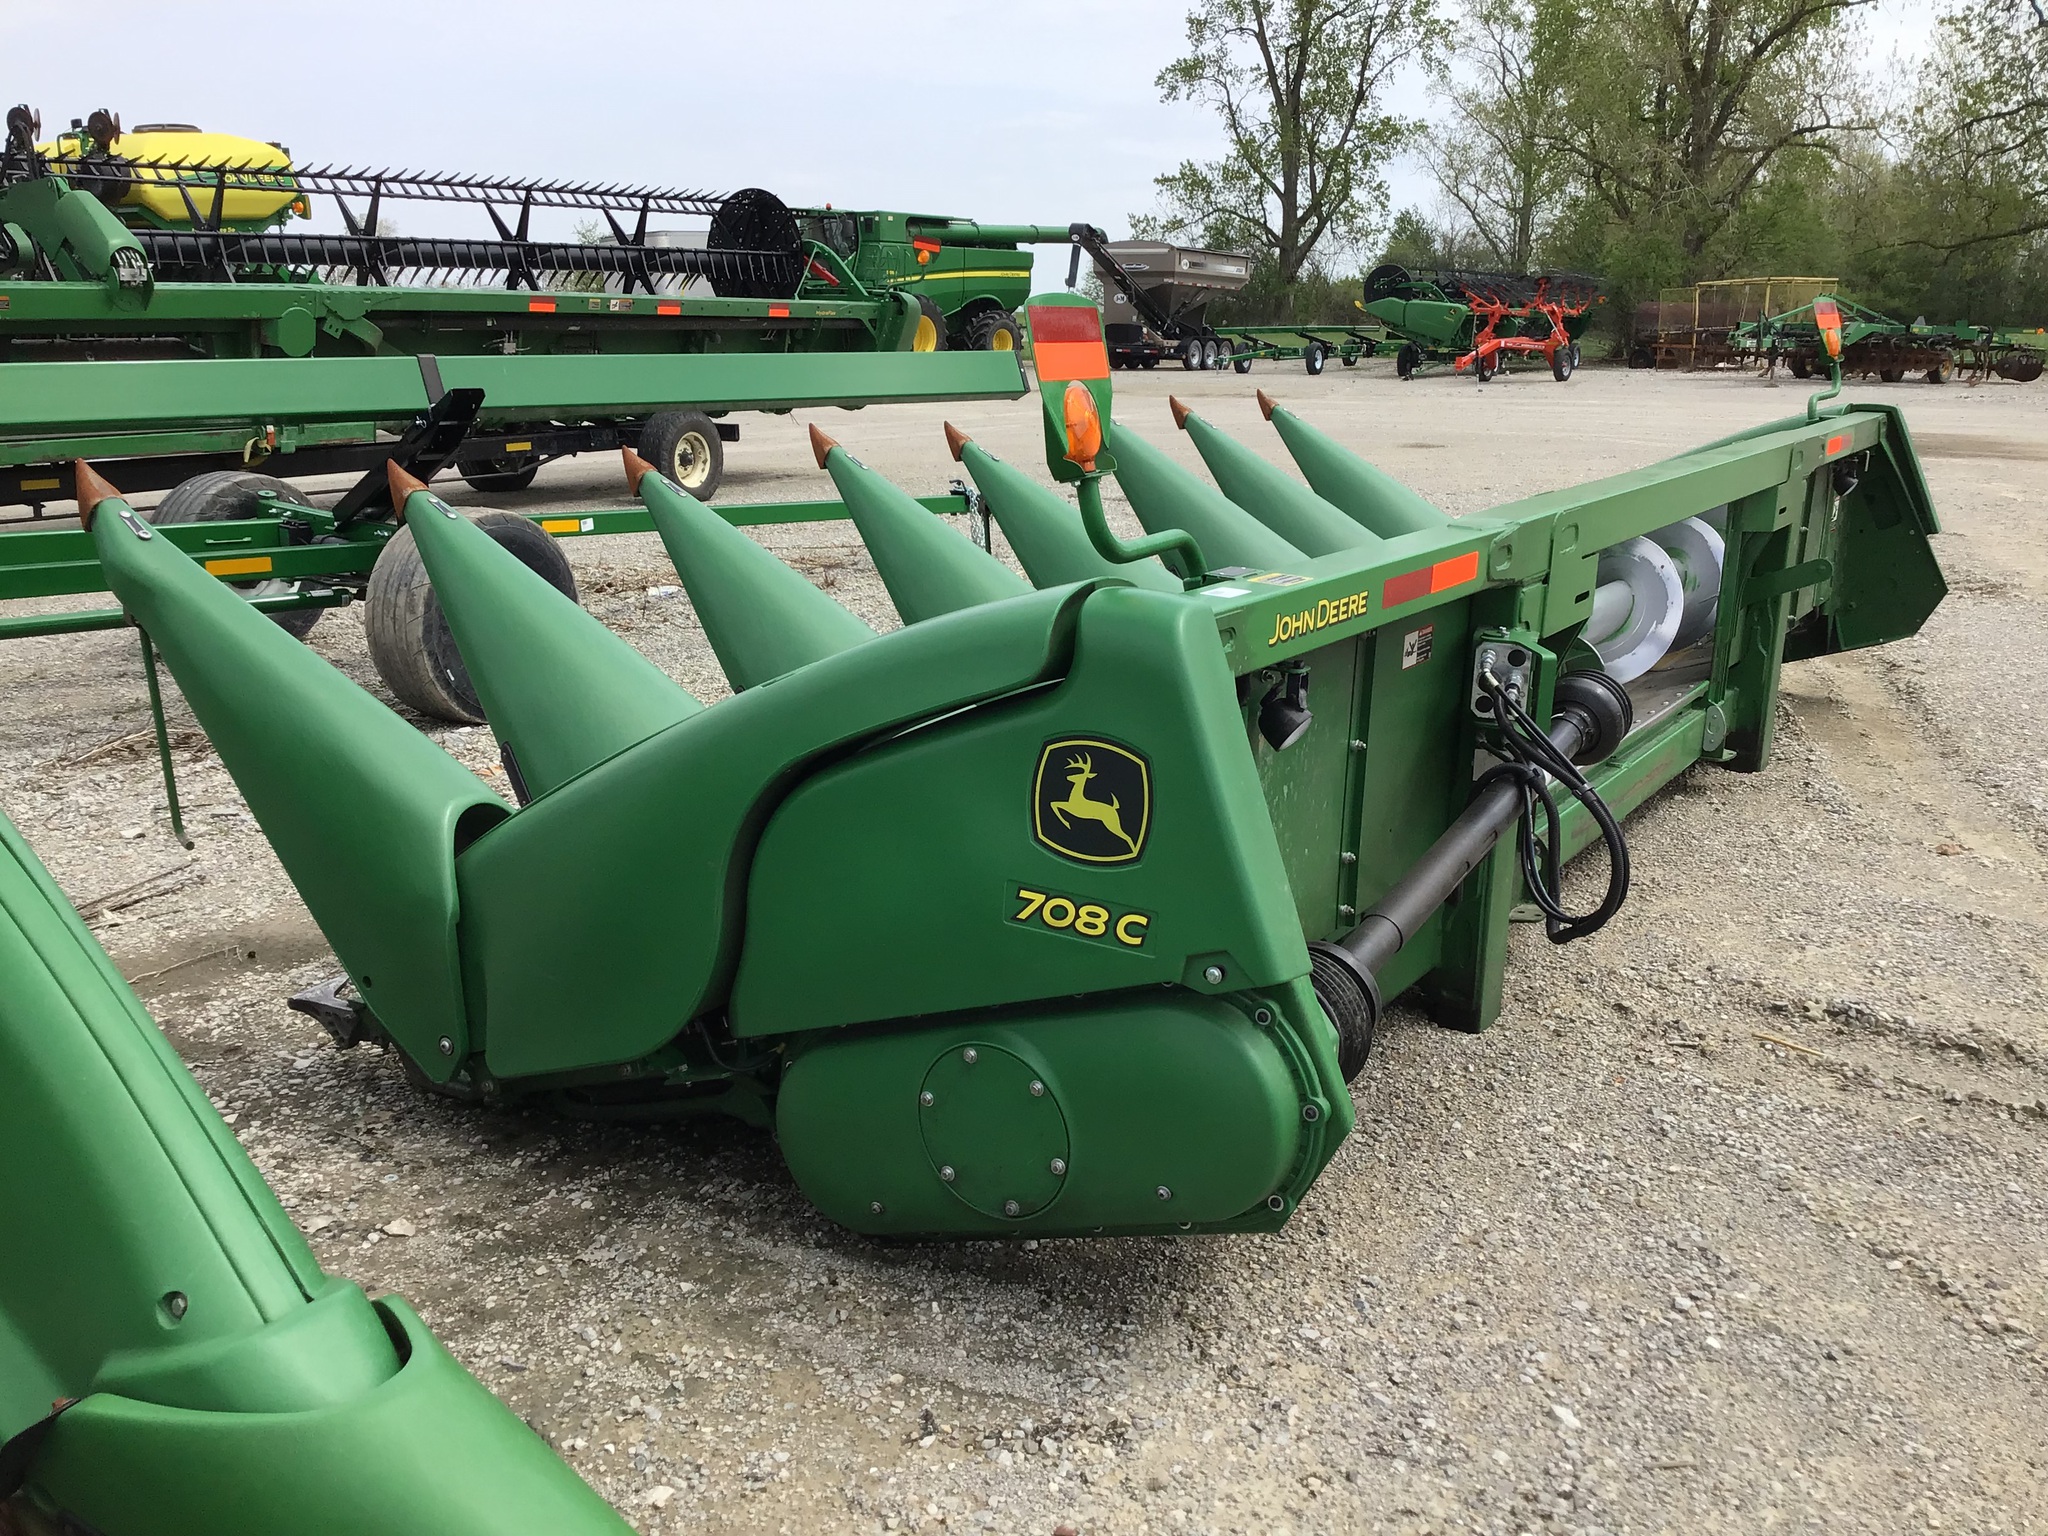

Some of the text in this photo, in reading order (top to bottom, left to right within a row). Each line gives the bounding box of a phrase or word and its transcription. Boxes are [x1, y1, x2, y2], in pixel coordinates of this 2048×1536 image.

[224, 173, 248, 183] OHN
[1268, 591, 1369, 645] JOHN DEERE
[1016, 889, 1148, 945] 708 C
